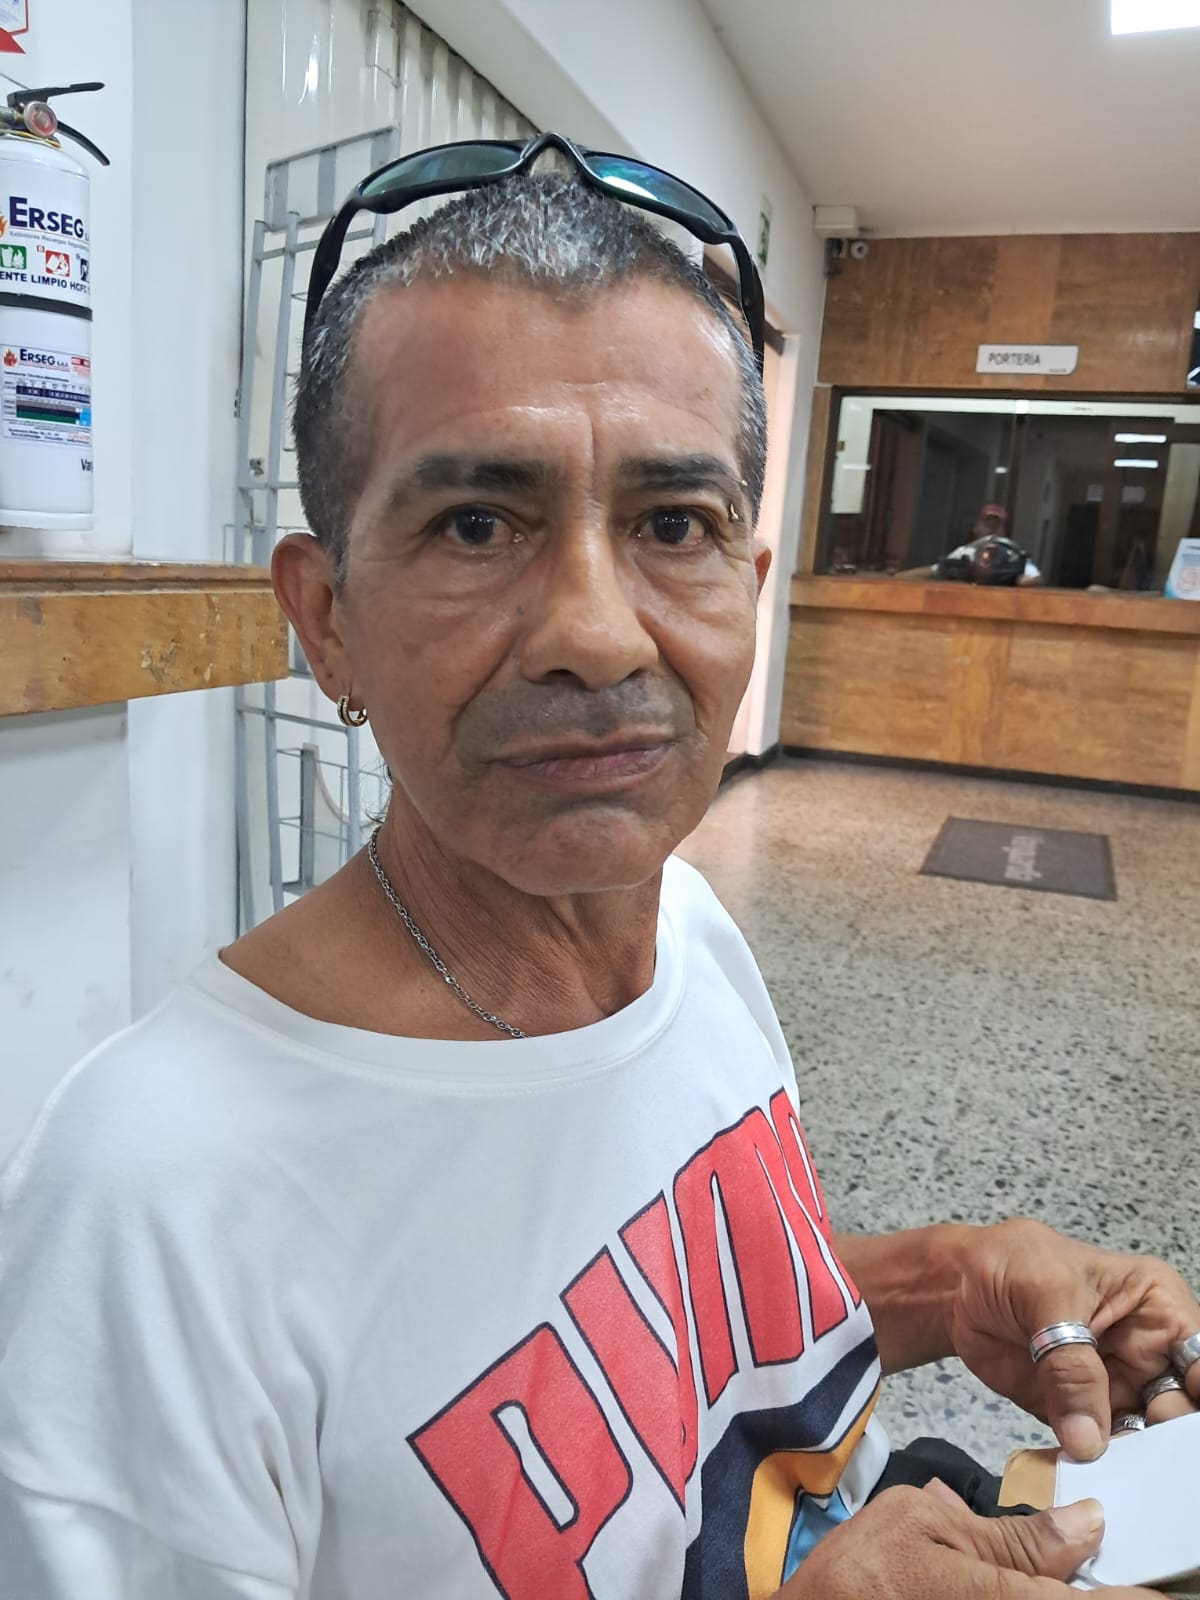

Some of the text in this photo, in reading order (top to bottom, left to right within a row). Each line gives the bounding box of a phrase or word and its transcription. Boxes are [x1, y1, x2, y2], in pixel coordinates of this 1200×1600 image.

[9, 196, 84, 239] ERSEG
[31, 274, 67, 288] LIMPIO
[20, 348, 56, 366] ERSEG
